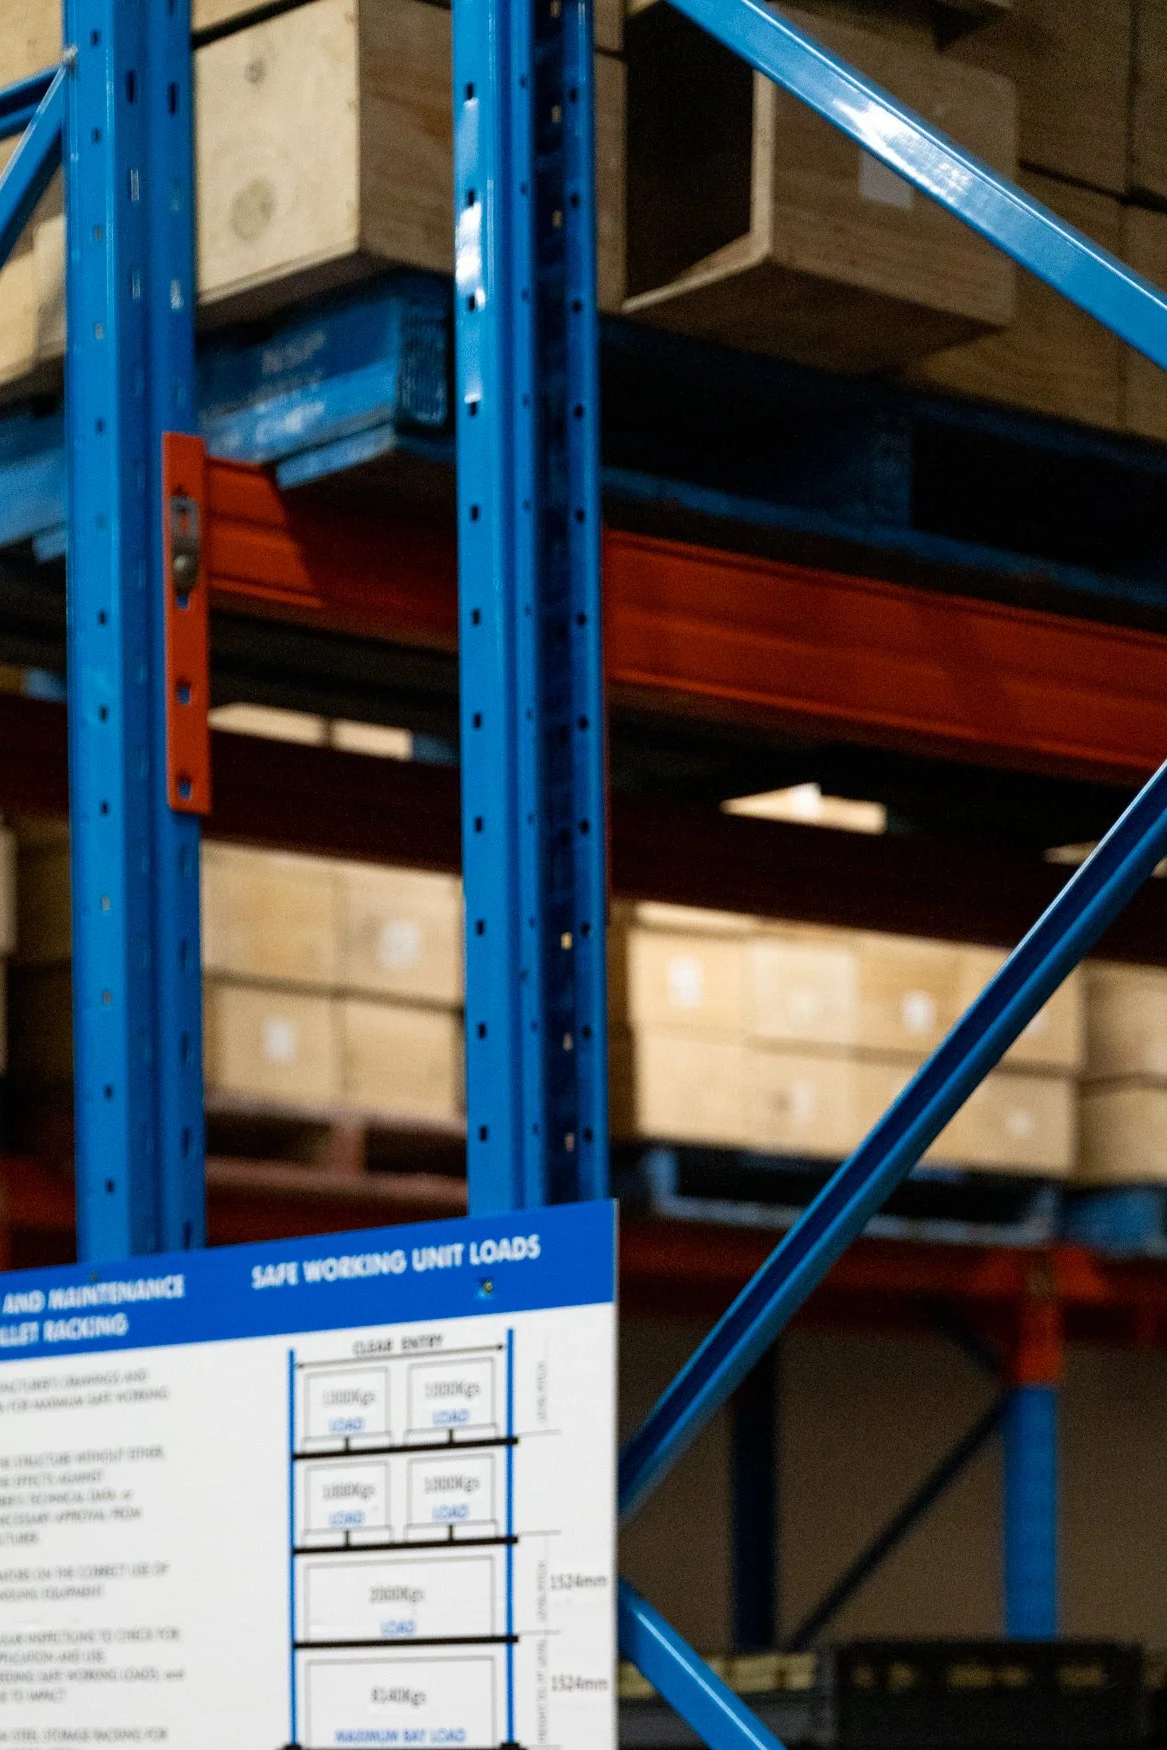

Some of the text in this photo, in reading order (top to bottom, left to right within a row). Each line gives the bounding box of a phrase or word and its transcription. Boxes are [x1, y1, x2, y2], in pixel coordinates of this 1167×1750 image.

[251, 1234, 542, 1290] SAFE WORKING UNIT LOADS
[2, 1290, 46, 1315] AND
[48, 1275, 185, 1310] MAINTENANCE
[43, 1312, 129, 1342] RACKING
[353, 1334, 445, 1355] CLEAR ENTRY
[329, 1416, 364, 1432] LOAD
[433, 1409, 470, 1425] LOAD
[329, 1511, 364, 1527] LOAD
[433, 1505, 469, 1522] LOAD
[550, 1574, 607, 1590] 1524mm
[381, 1620, 417, 1636] LOAD
[551, 1675, 609, 1692] 1524mm
[431, 1728, 466, 1743] LOAD
